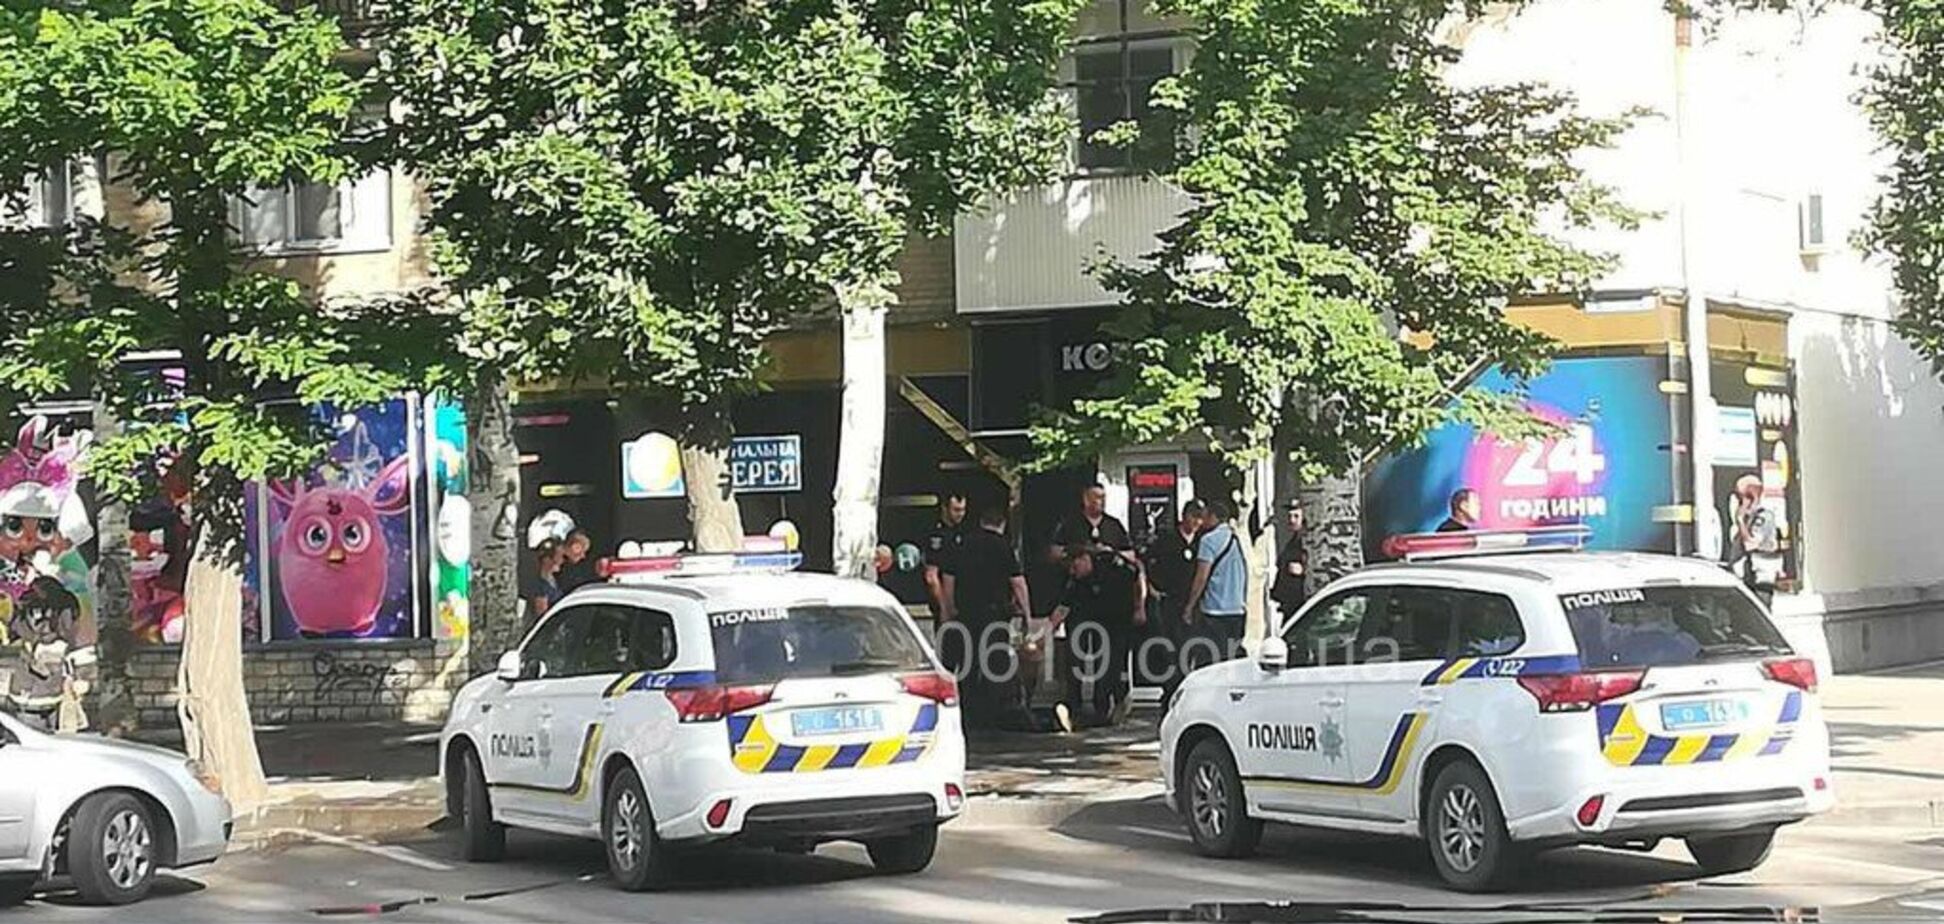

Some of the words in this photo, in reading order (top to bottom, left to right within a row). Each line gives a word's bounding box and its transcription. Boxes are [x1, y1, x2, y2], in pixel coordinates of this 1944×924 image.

[1501, 421, 1605, 485] 24
[732, 459, 796, 486] ЕРЕЯ
[1248, 723, 1317, 751] ПОЛІЦІЯ
